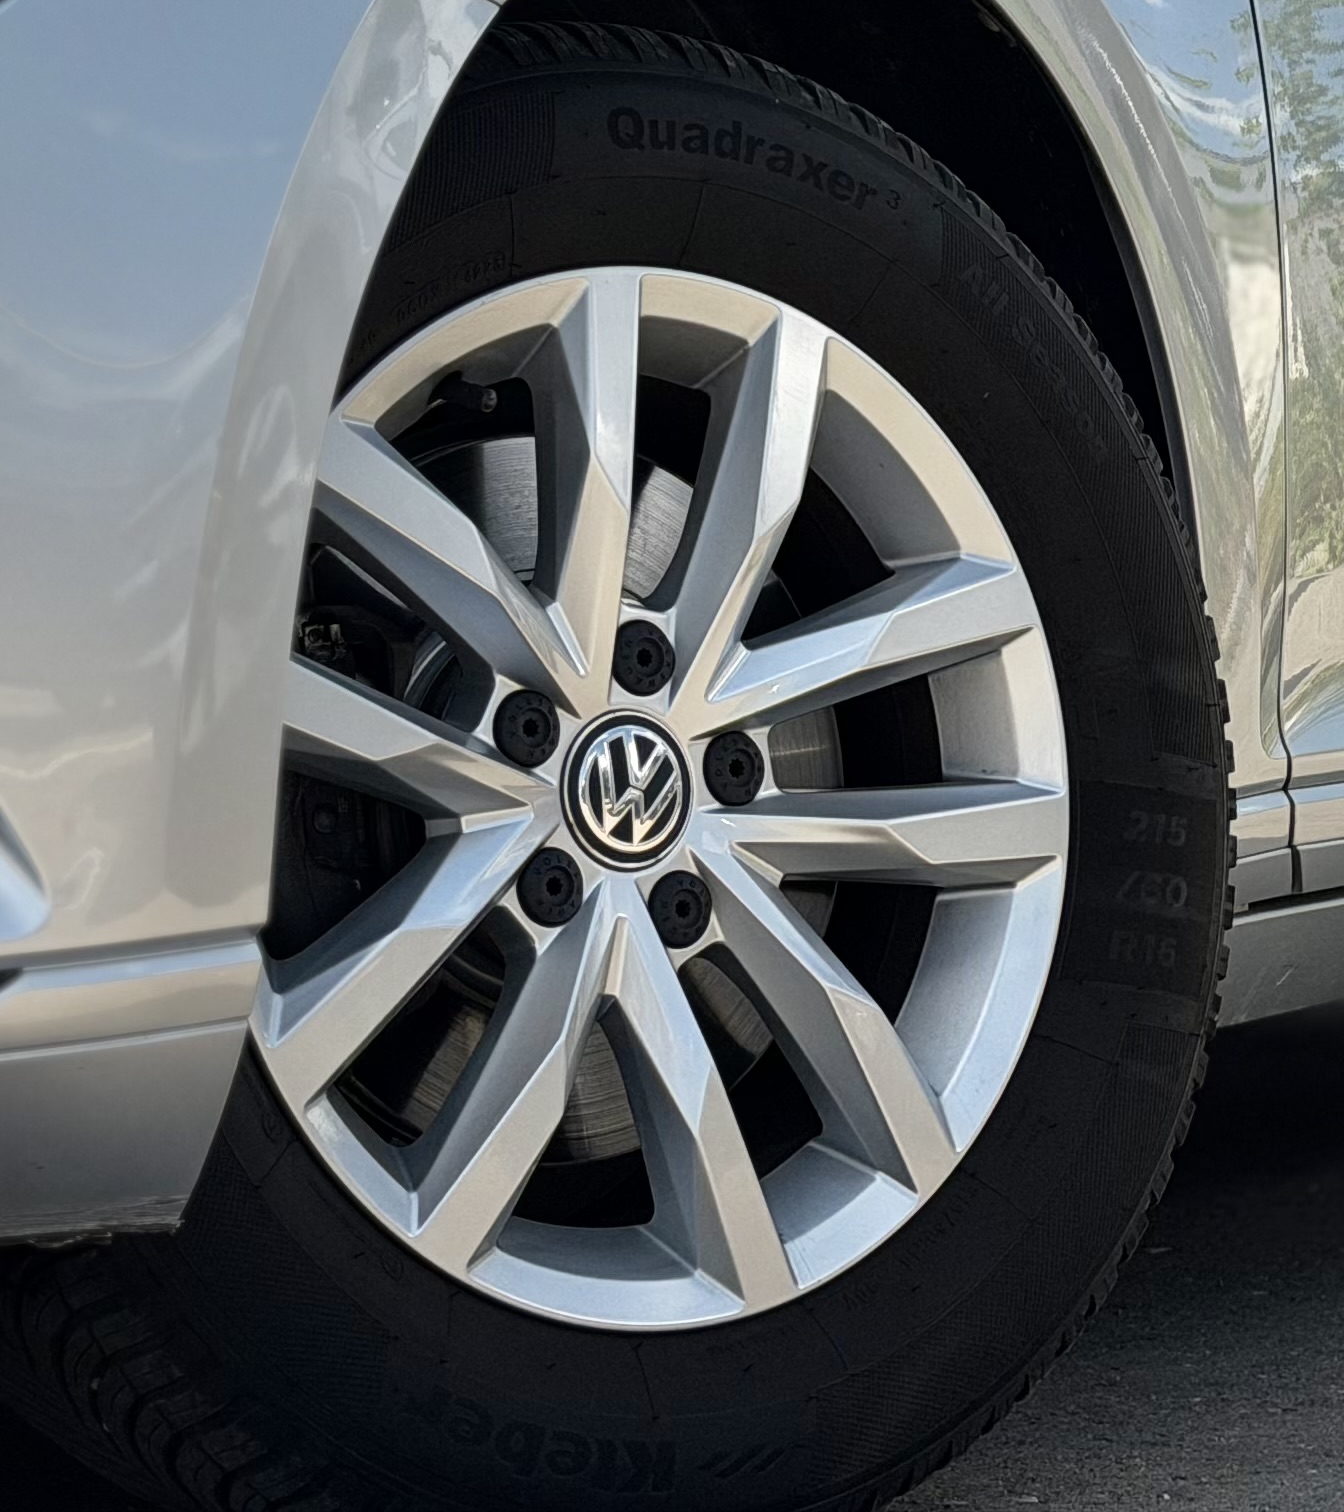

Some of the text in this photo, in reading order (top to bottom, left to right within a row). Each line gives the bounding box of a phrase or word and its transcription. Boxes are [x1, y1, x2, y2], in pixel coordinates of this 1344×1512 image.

[606, 105, 878, 212] Quadraxer
[959, 263, 1010, 316] All
[1122, 809, 1189, 848] 215
[404, 1386, 678, 1494] Kleber
